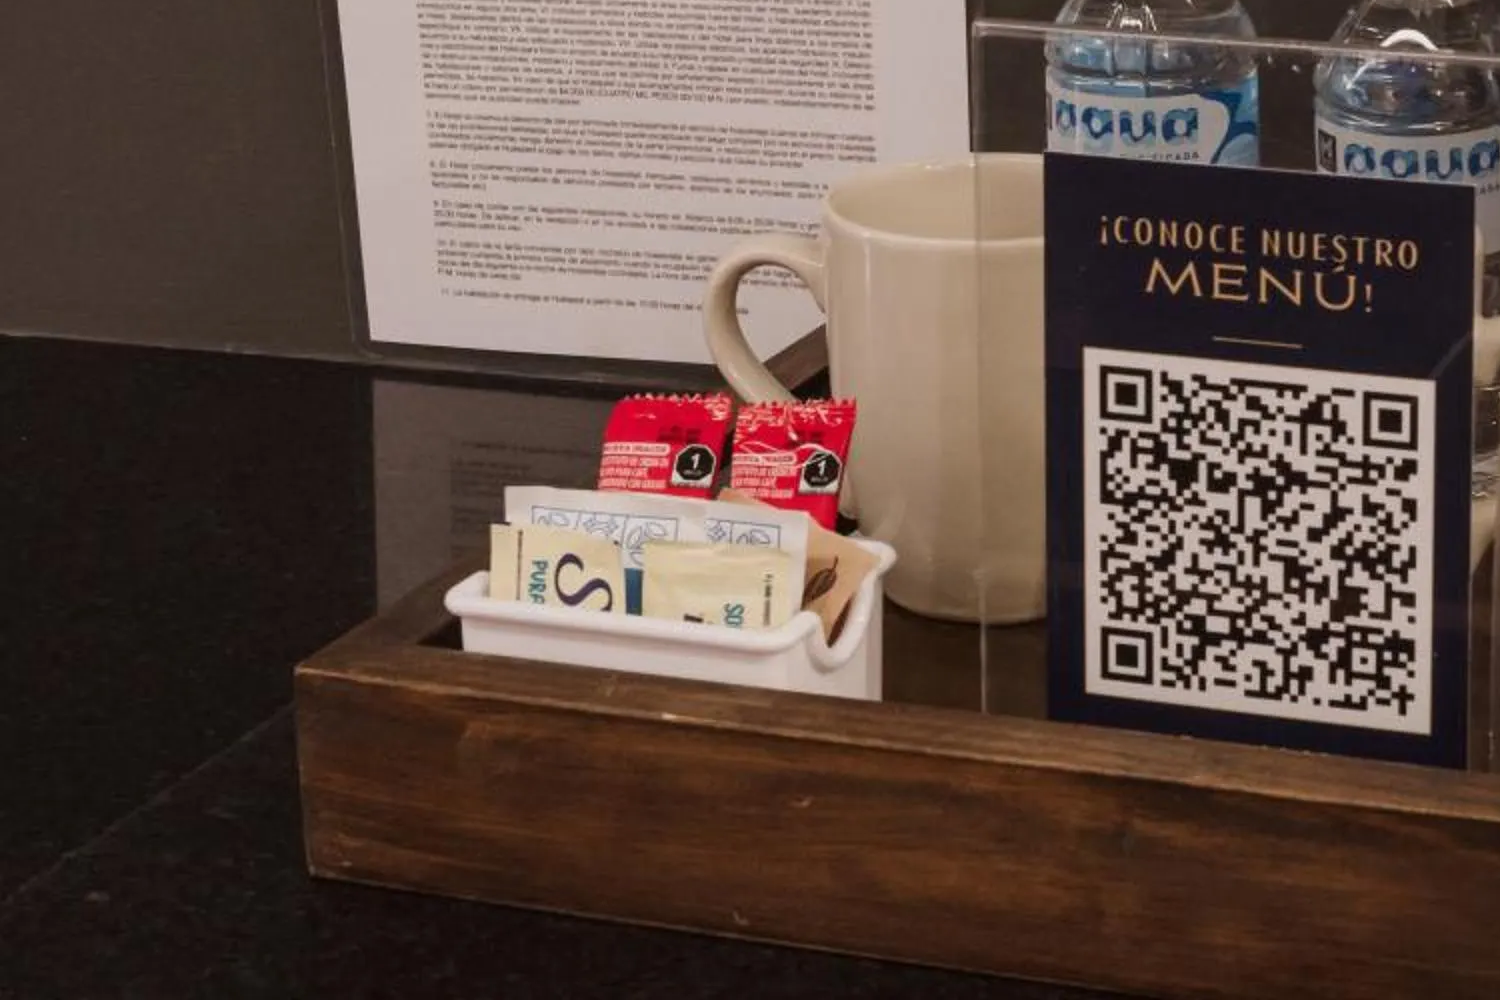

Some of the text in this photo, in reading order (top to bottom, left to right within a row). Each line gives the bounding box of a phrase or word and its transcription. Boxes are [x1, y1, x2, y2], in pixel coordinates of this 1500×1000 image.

[1099, 214, 1419, 271] ¡CONOCE NUESTRO
[1145, 255, 1374, 314] MENÚ!
[691, 452, 701, 470] 1
[818, 458, 827, 477] 1
